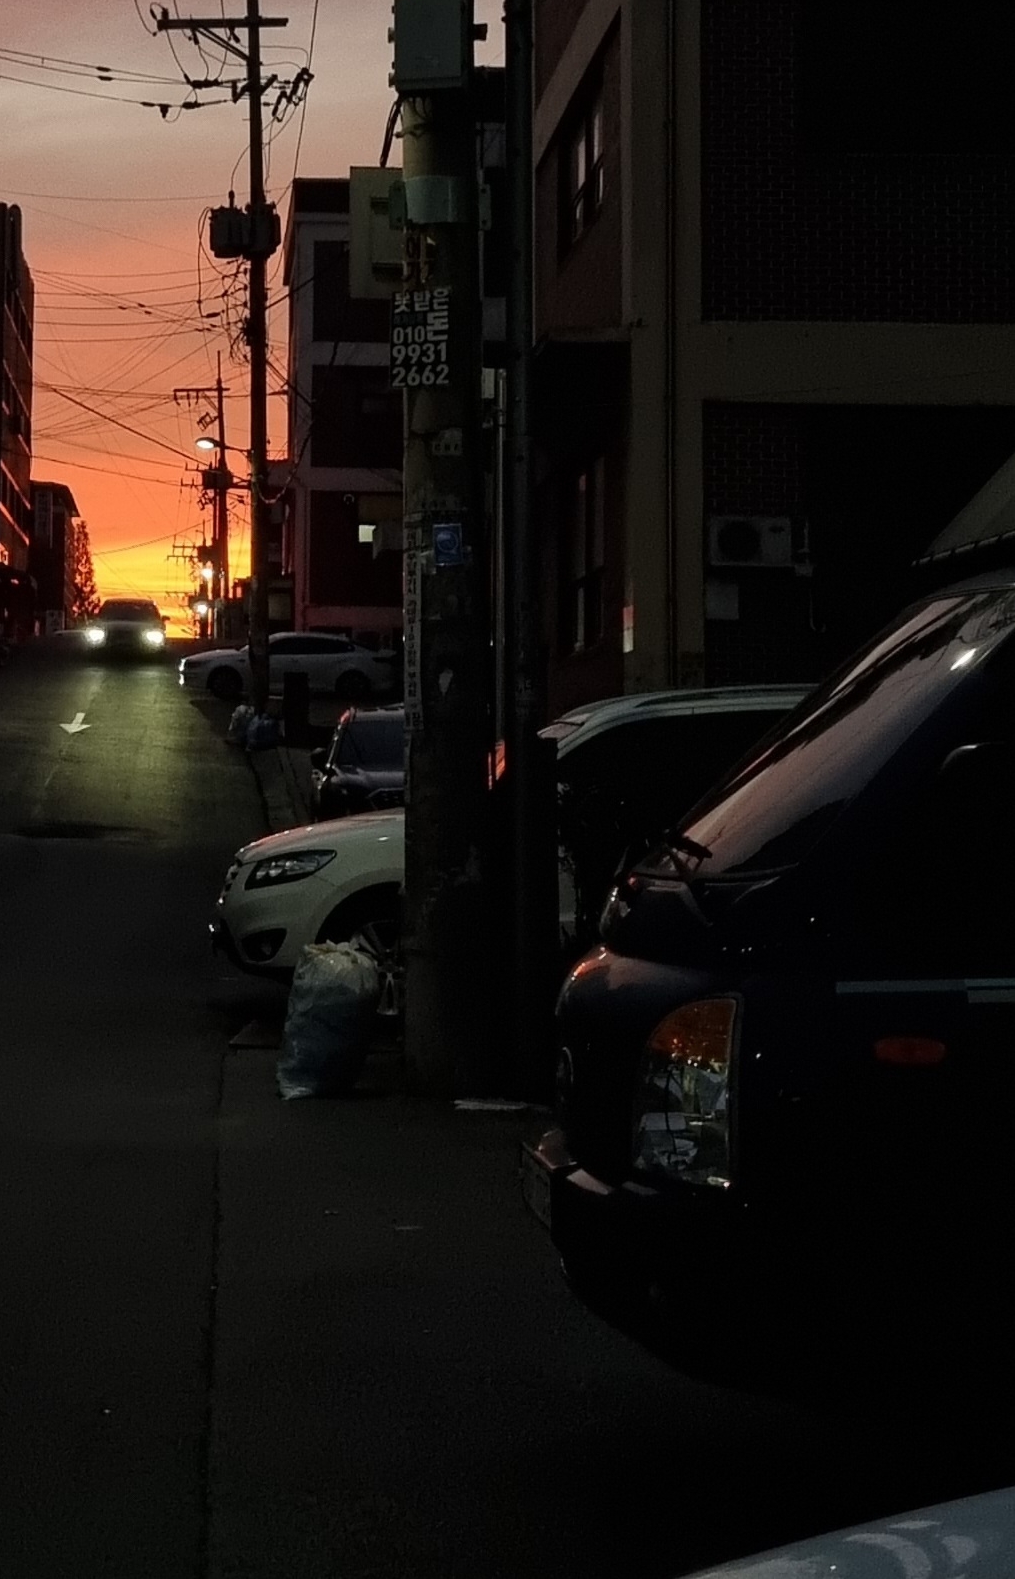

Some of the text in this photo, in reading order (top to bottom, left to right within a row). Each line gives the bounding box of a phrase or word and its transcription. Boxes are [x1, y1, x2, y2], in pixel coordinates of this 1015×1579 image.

[392, 325, 426, 345] 010
[426, 311, 450, 342] 돈
[391, 341, 449, 366] 9931
[391, 363, 450, 388] 2662
